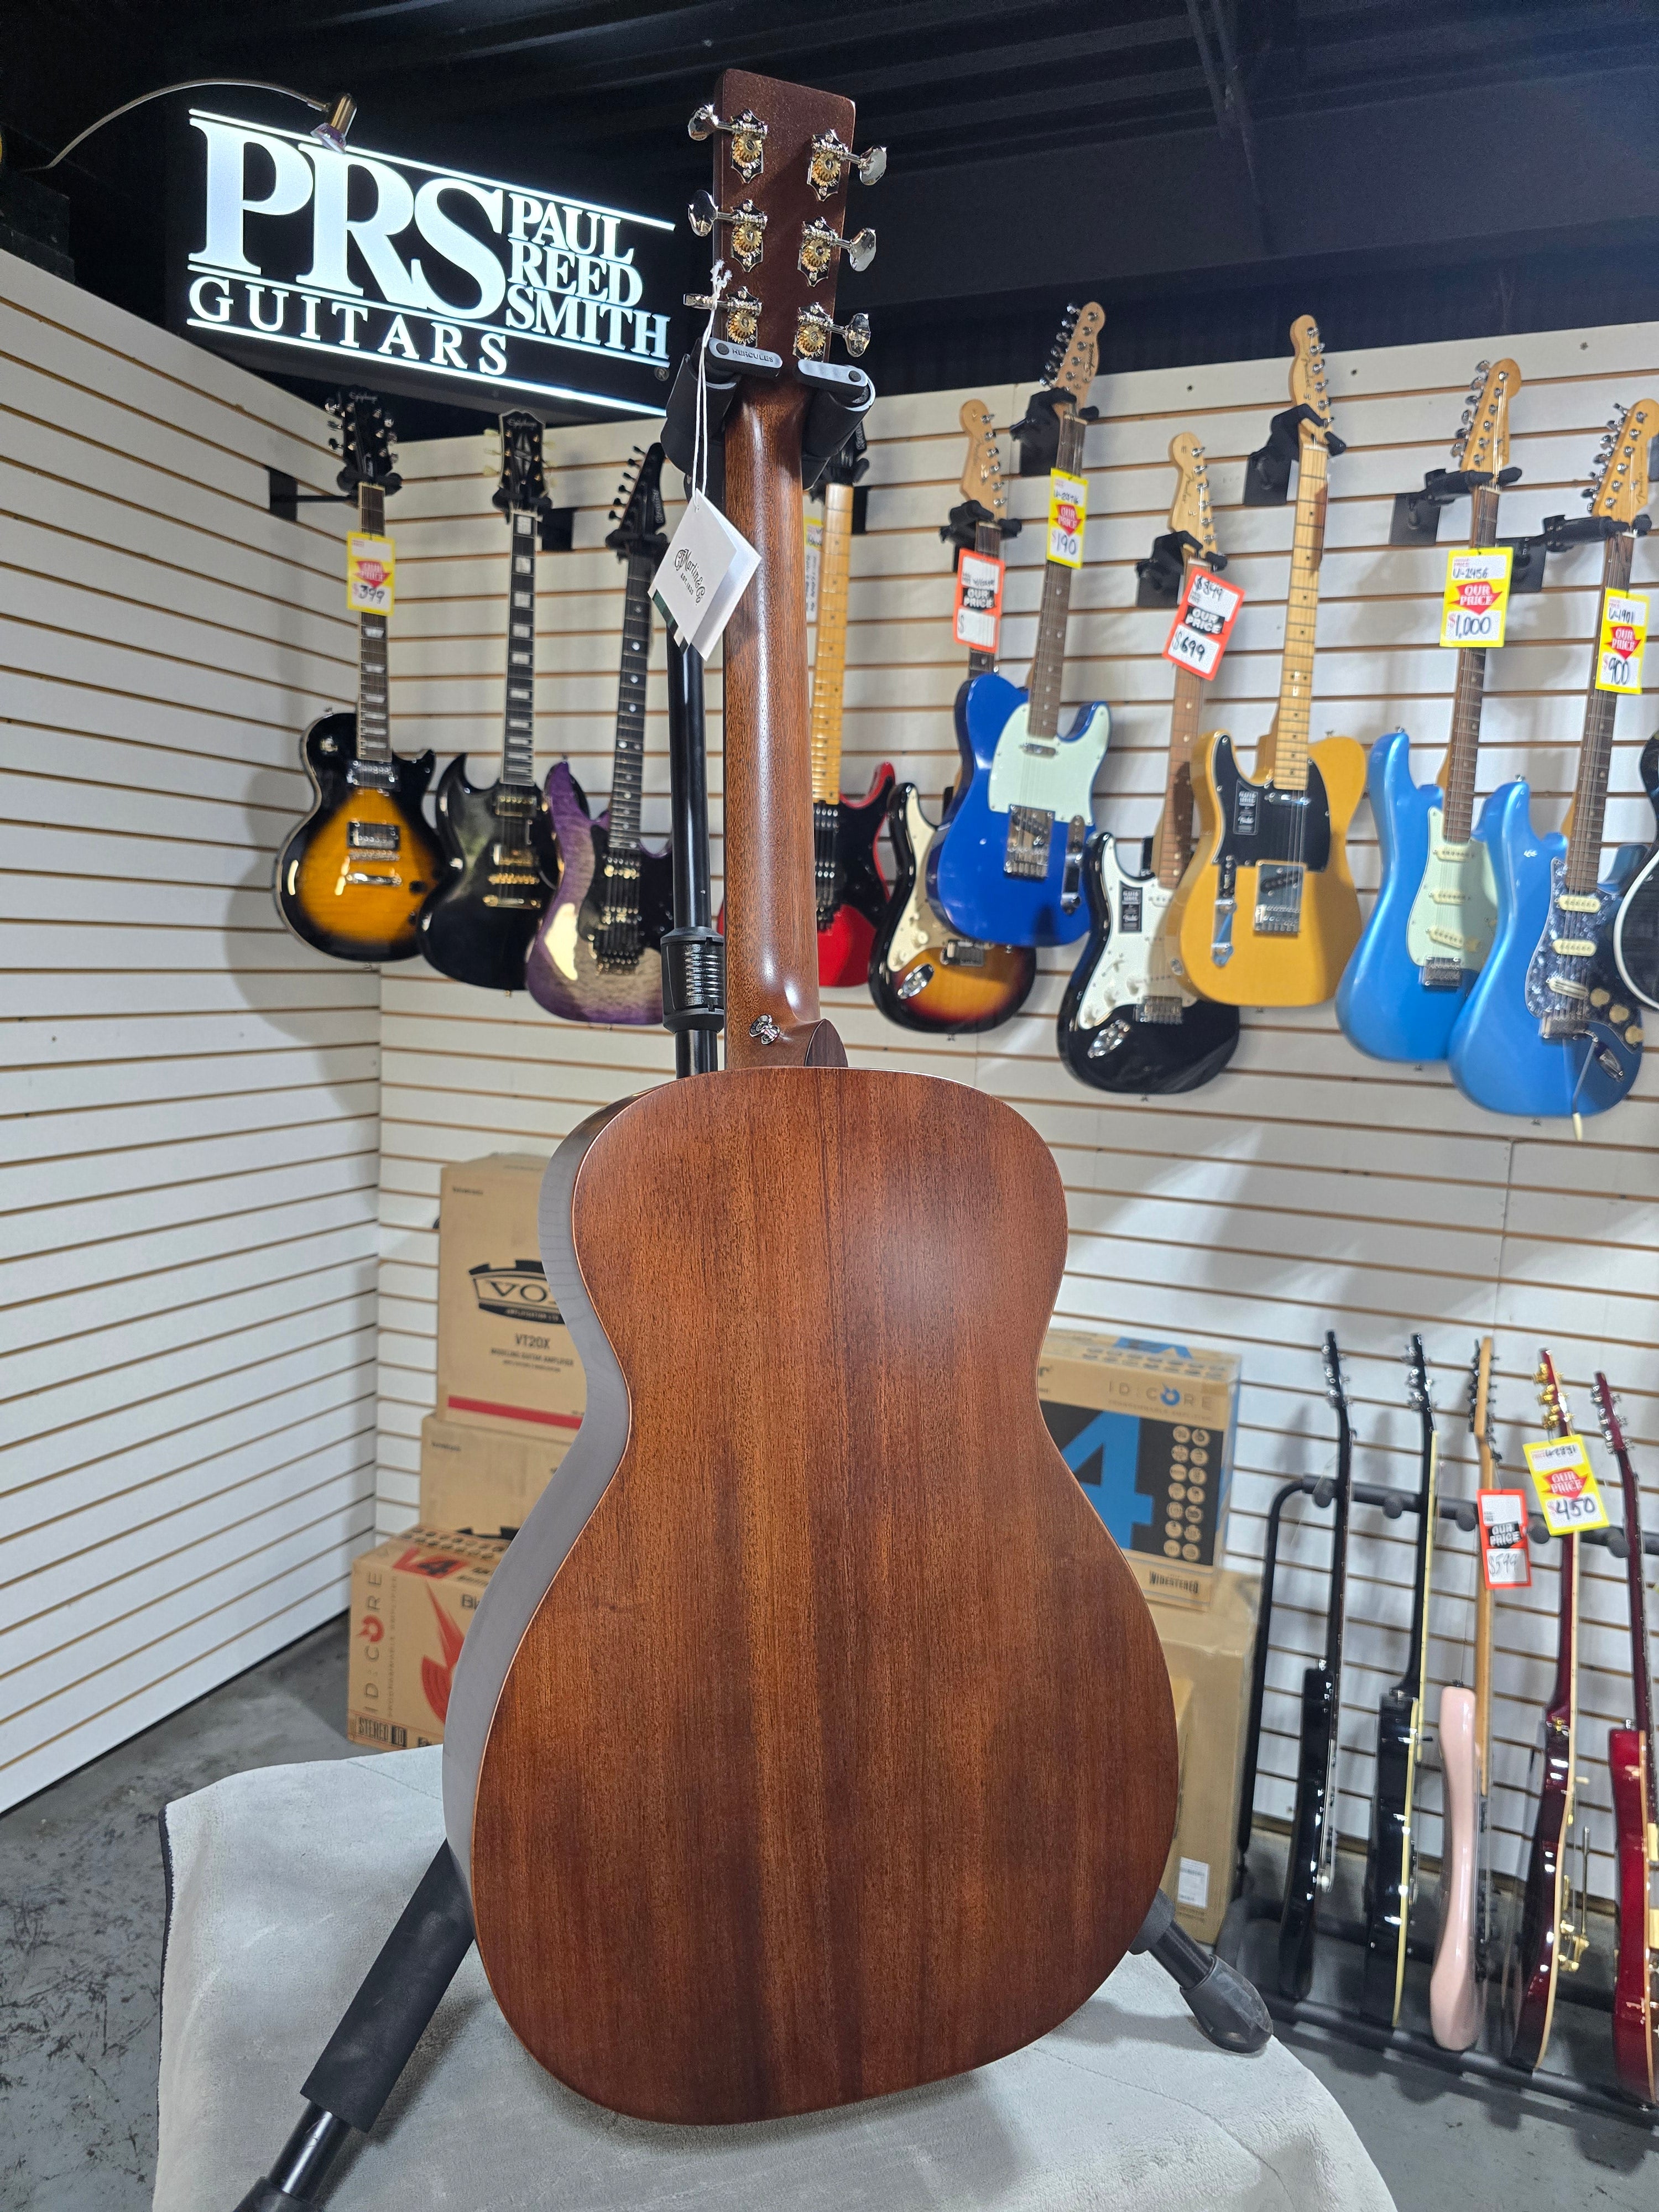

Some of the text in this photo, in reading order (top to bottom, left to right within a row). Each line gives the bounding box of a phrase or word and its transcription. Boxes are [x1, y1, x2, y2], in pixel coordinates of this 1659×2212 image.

[189, 117, 505, 319] PRS
[508, 192, 634, 265] PAUL
[507, 238, 643, 309] REED
[188, 275, 508, 376] GUITARS
[505, 284, 671, 360] SMITH
[732, 348, 774, 362] HERCULES
[967, 587, 990, 599] OUR
[1464, 585, 1490, 596] OUR
[963, 595, 994, 608] PRICE
[1459, 595, 1493, 606] PRICE
[1185, 614, 1222, 634] PRICE
[1192, 608, 1219, 624] OUR
[1615, 628, 1634, 640] OUR
[1172, 631, 1205, 662] $699
[1611, 638, 1635, 651] PRICE
[486, 1280, 556, 1305] VO
[515, 1333, 551, 1349] VT20X
[1551, 1471, 1575, 1484] OUR
[1551, 1479, 1582, 1494] PRICE
[1492, 1523, 1514, 1535] OUR
[1489, 1531, 1520, 1547] PRICE
